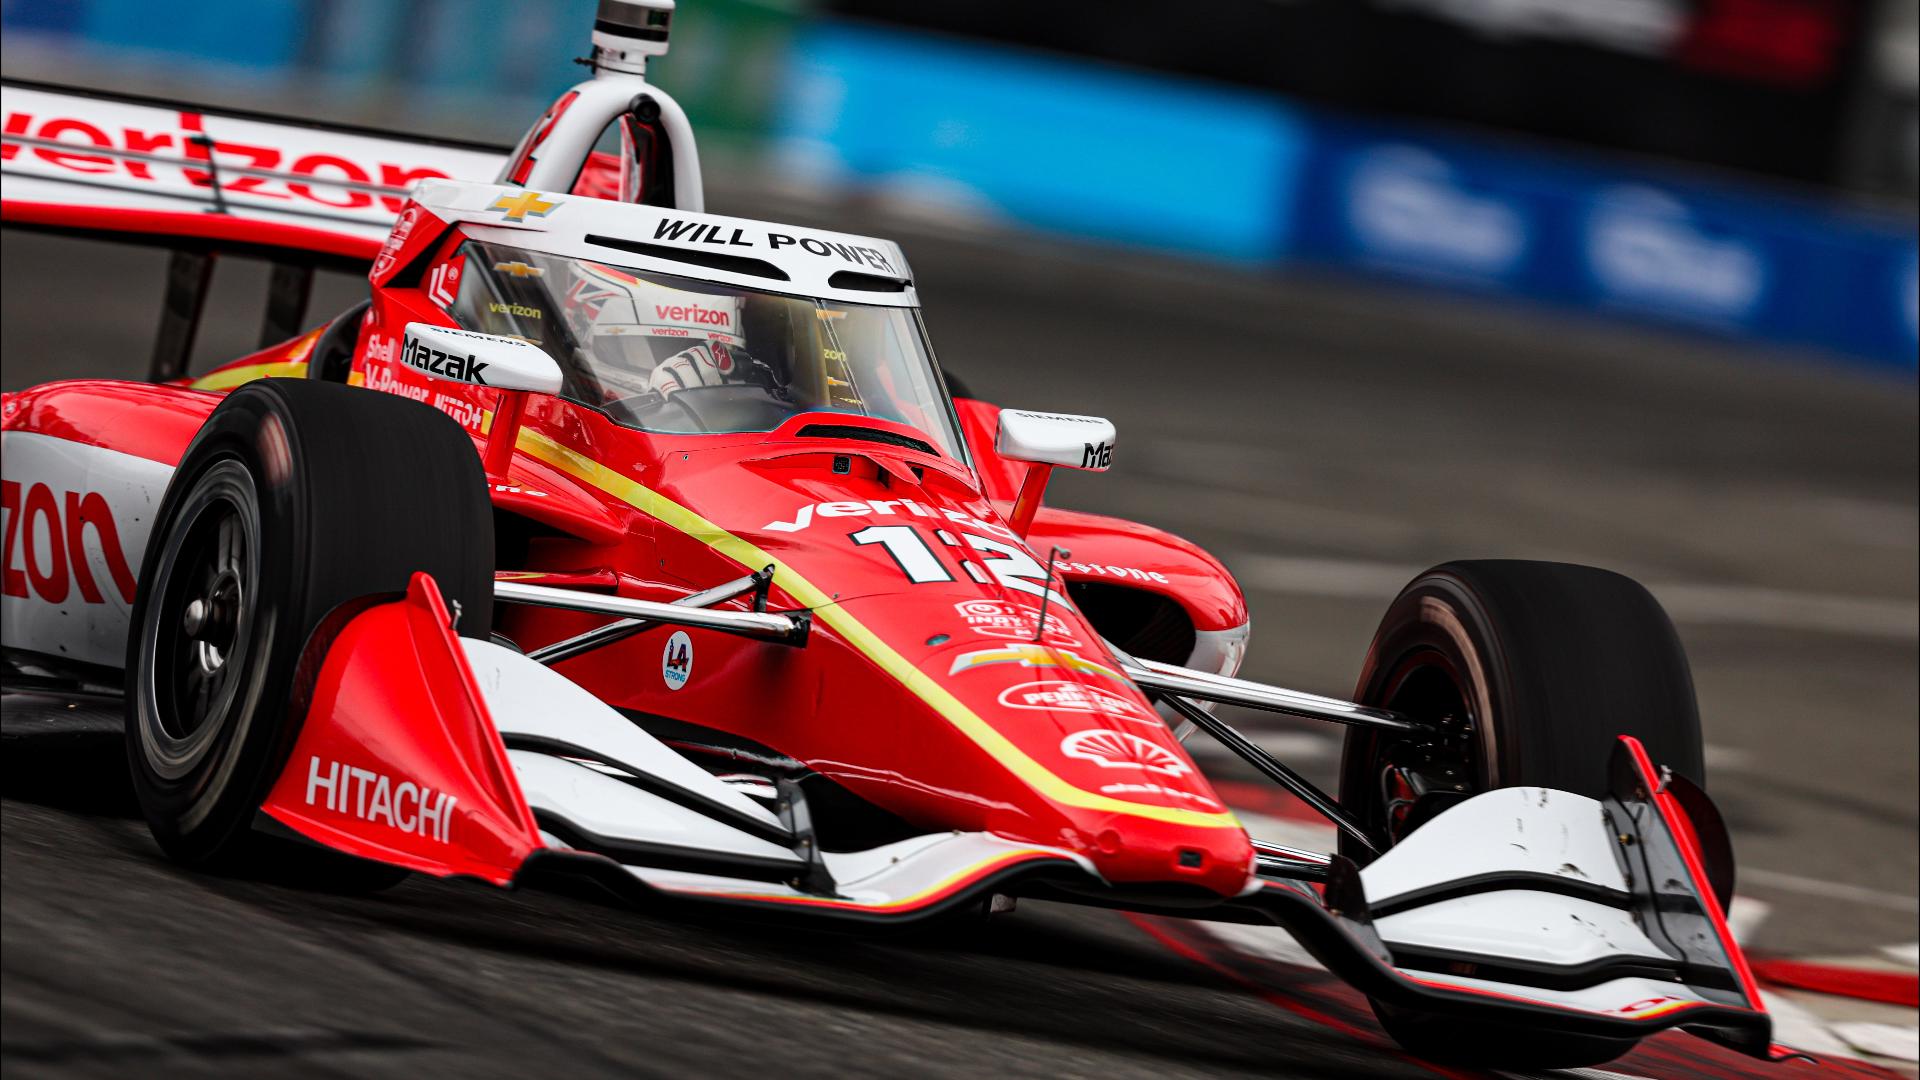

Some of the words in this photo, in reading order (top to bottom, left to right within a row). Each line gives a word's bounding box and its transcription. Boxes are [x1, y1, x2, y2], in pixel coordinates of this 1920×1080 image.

[653, 218, 754, 247] WILL
[767, 232, 897, 275] POWER
[489, 302, 542, 319] verizon
[655, 303, 730, 327] verizon
[651, 327, 689, 337] verizon
[366, 333, 397, 363] Shell
[400, 332, 490, 386] Mazak
[1080, 441, 1114, 469] Ma
[846, 524, 1077, 614] 12
[1045, 559, 1169, 584] estone
[665, 669, 686, 682] STRONG
[305, 755, 458, 845] HITACHI
